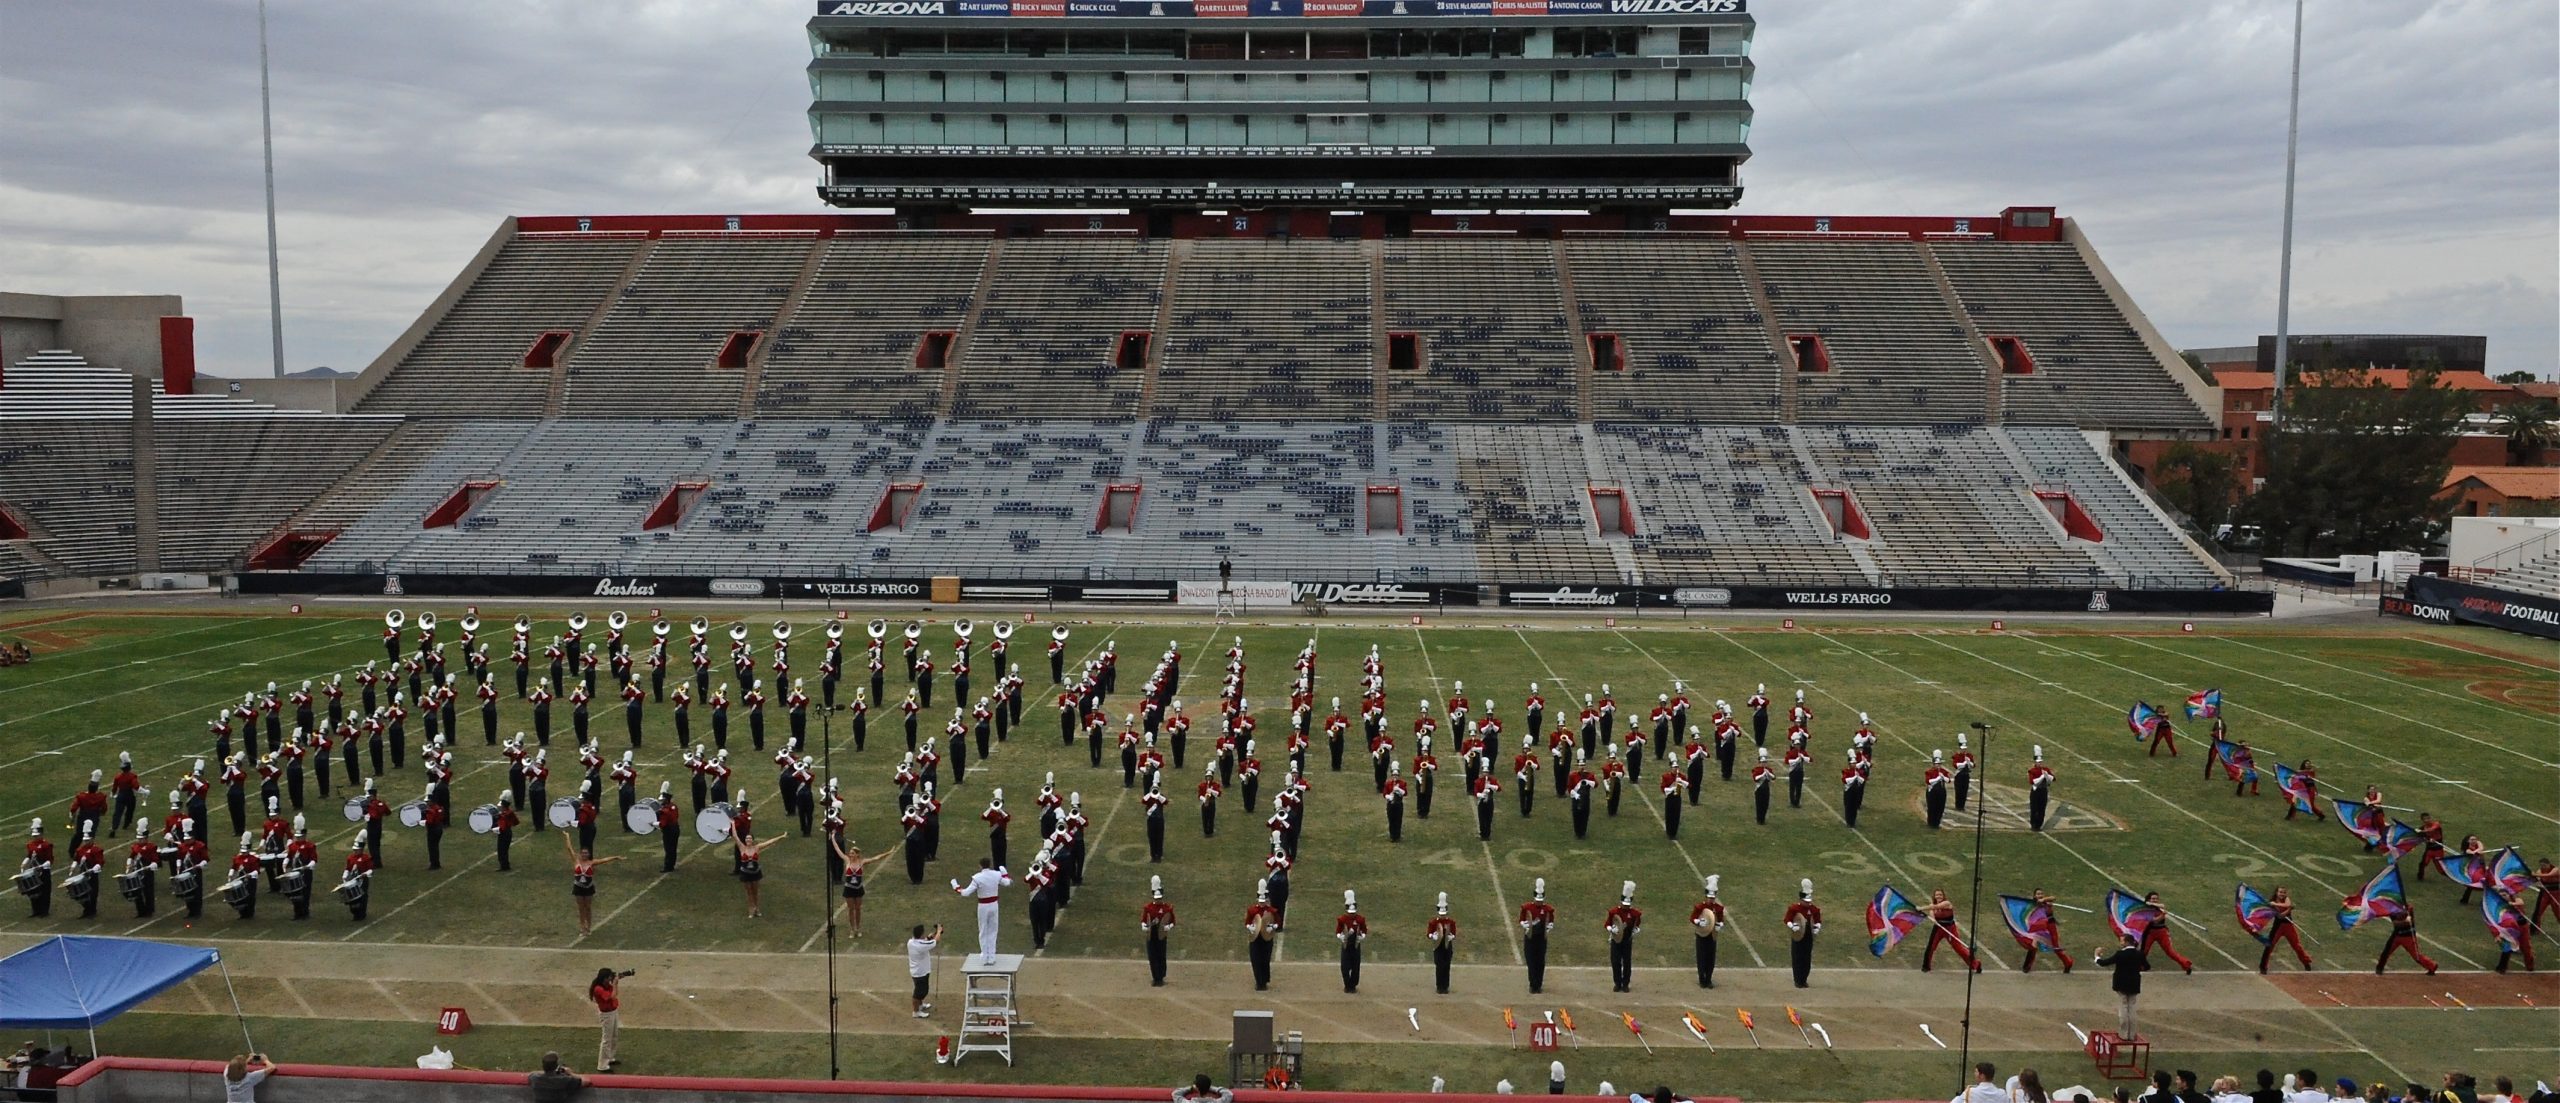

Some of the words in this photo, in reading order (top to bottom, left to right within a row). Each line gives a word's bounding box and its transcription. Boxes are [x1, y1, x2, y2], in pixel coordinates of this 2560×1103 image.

[831, 2, 945, 15] ARIZONA
[959, 2, 968, 10] 22
[968, 3, 980, 11] ART
[1021, 3, 1040, 11] RICKY
[1041, 3, 1065, 11] HUNLEY
[1076, 3, 1098, 11] CHUCK
[1099, 3, 1116, 11] CECIL
[1228, 4, 1247, 12] LEWIS
[1312, 3, 1326, 11] BOB
[1327, 3, 1358, 11] WALDROP
[1554, 2, 1580, 10] ANTOINE
[1580, 2, 1603, 10] CASON
[1611, 0, 1738, 13] WILDCATS
[579, 222, 590, 232] 17
[728, 222, 739, 231] 18
[1089, 221, 1102, 230] 20
[1235, 221, 1247, 230] 21
[1456, 221, 1469, 231] 22
[1816, 223, 1829, 232] 24
[1955, 224, 1969, 233] 25
[230, 382, 241, 391] 16
[594, 578, 657, 596] Bashas'
[817, 584, 870, 595] WELLS
[870, 584, 919, 595] FARGO
[1180, 588, 1214, 598] UNIVERSITY
[1256, 588, 1274, 598] BAND
[1275, 588, 1289, 598] DAY
[1786, 593, 1838, 604] WELLS
[1841, 593, 1892, 604] FARGO
[2384, 598, 2414, 613] BEAR
[2413, 603, 2450, 620] DOWN
[2462, 596, 2504, 615] ARIZONA
[2503, 603, 2560, 625] FOOTBALL
[2212, 853, 2364, 878] 20
[441, 1011, 459, 1031] 40
[1534, 1027, 1553, 1047] 40
